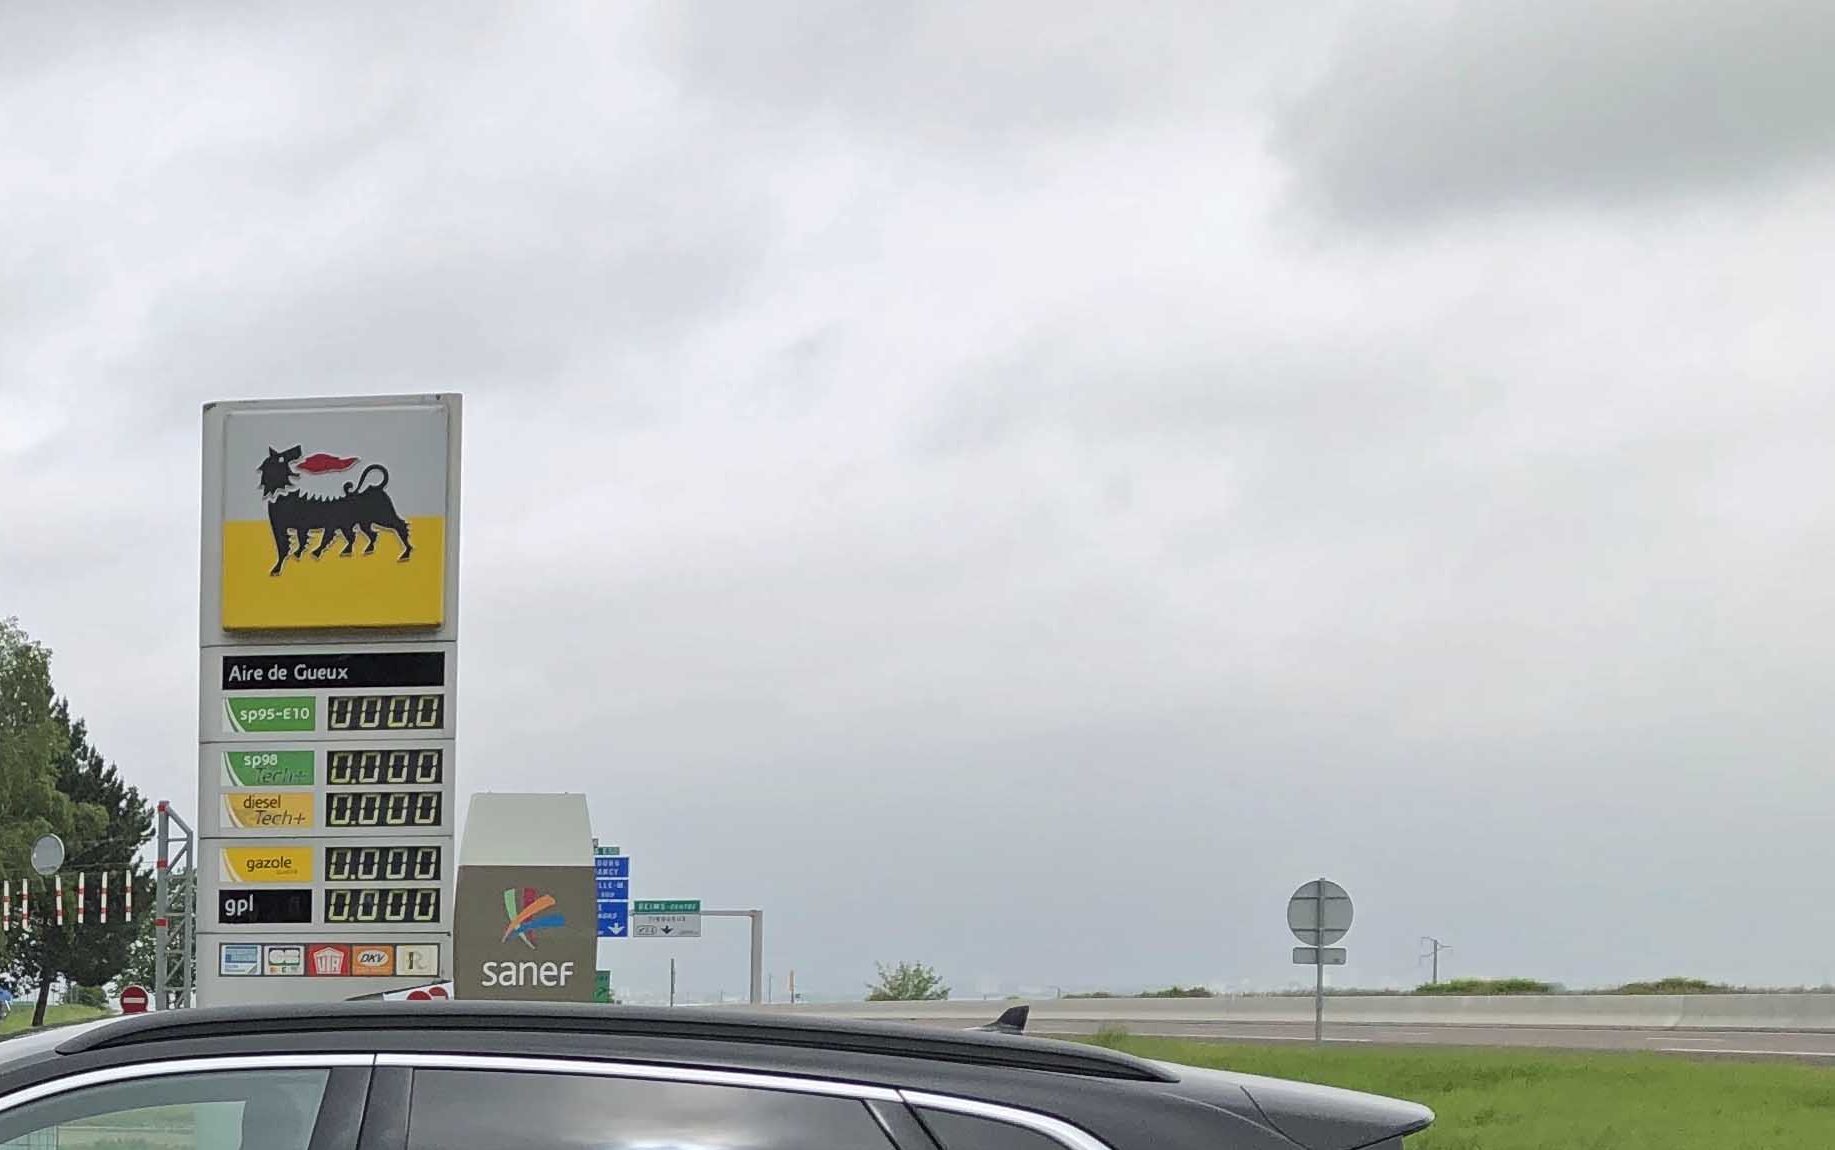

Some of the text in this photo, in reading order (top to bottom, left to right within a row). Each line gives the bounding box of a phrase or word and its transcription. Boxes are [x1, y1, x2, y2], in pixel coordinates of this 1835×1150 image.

[228, 664, 349, 682] Aire de Gueux
[239, 707, 310, 724] sp95-E10
[243, 754, 278, 768] sp98
[243, 794, 282, 809] diesel
[254, 810, 306, 825] Tech+
[246, 856, 293, 872] gazole
[224, 894, 254, 917] gpl
[359, 953, 385, 963] DKV
[481, 961, 574, 987] sanef
